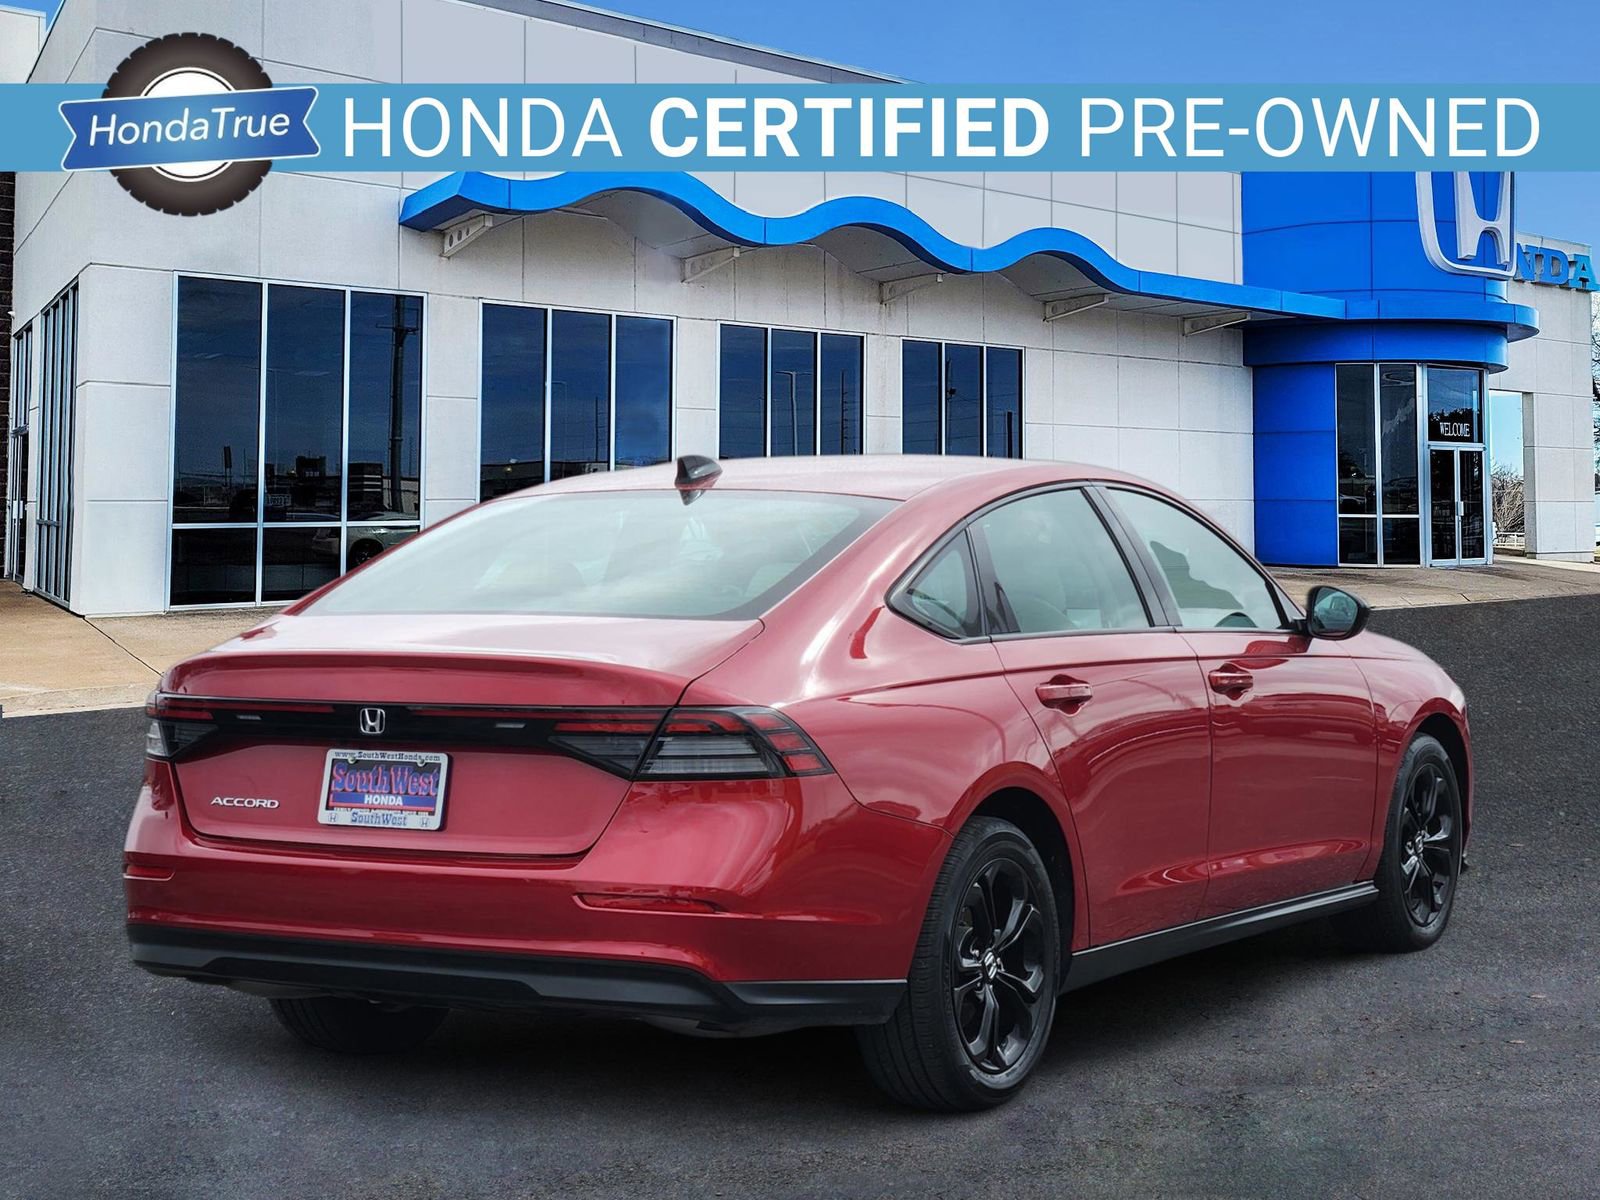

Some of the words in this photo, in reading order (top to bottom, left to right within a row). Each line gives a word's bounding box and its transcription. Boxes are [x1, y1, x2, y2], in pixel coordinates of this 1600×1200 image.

[1516, 243, 1600, 292] NDA
[1439, 421, 1471, 438] WELCOME
[210, 796, 280, 810] ACCORD
[363, 794, 403, 806] HONDA
[351, 812, 407, 826] SouthWest
